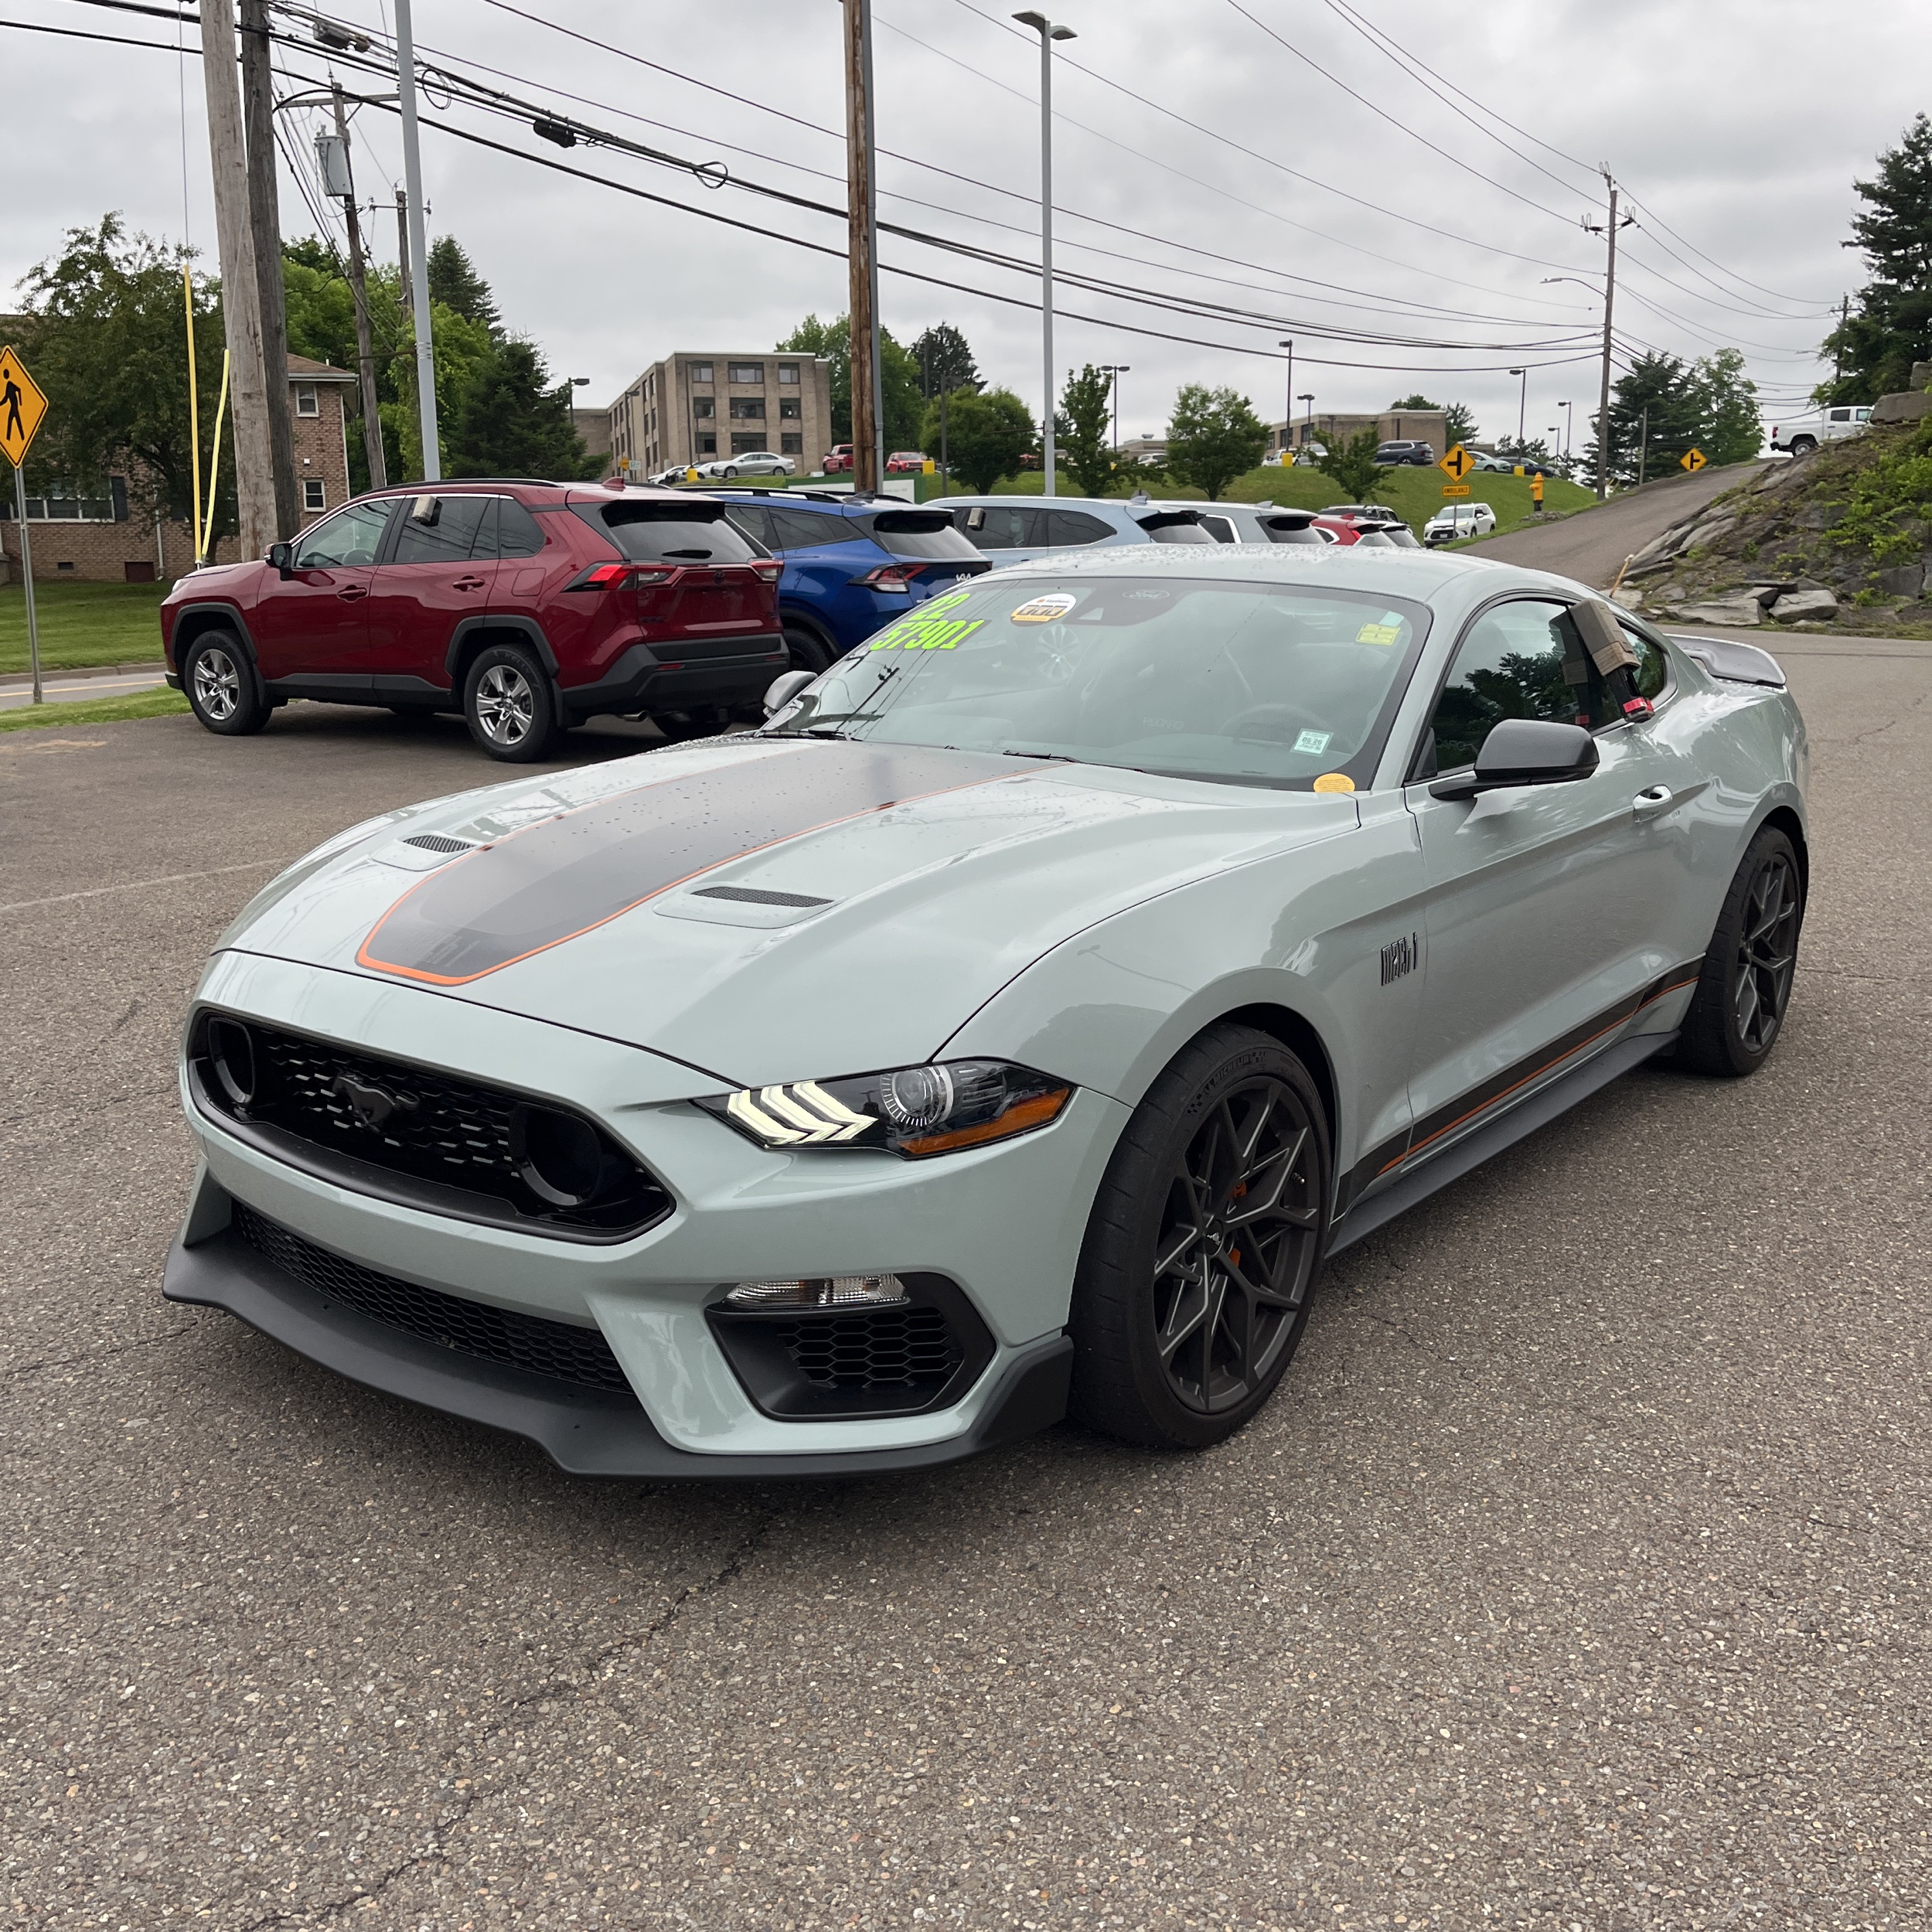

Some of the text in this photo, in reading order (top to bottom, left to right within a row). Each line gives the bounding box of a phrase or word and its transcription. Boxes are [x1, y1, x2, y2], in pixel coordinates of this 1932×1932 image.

[956, 573, 972, 582] KIA
[911, 593, 970, 619] 22
[871, 619, 985, 650] 57901
[1214, 1054, 1252, 1084] MICHELIN
